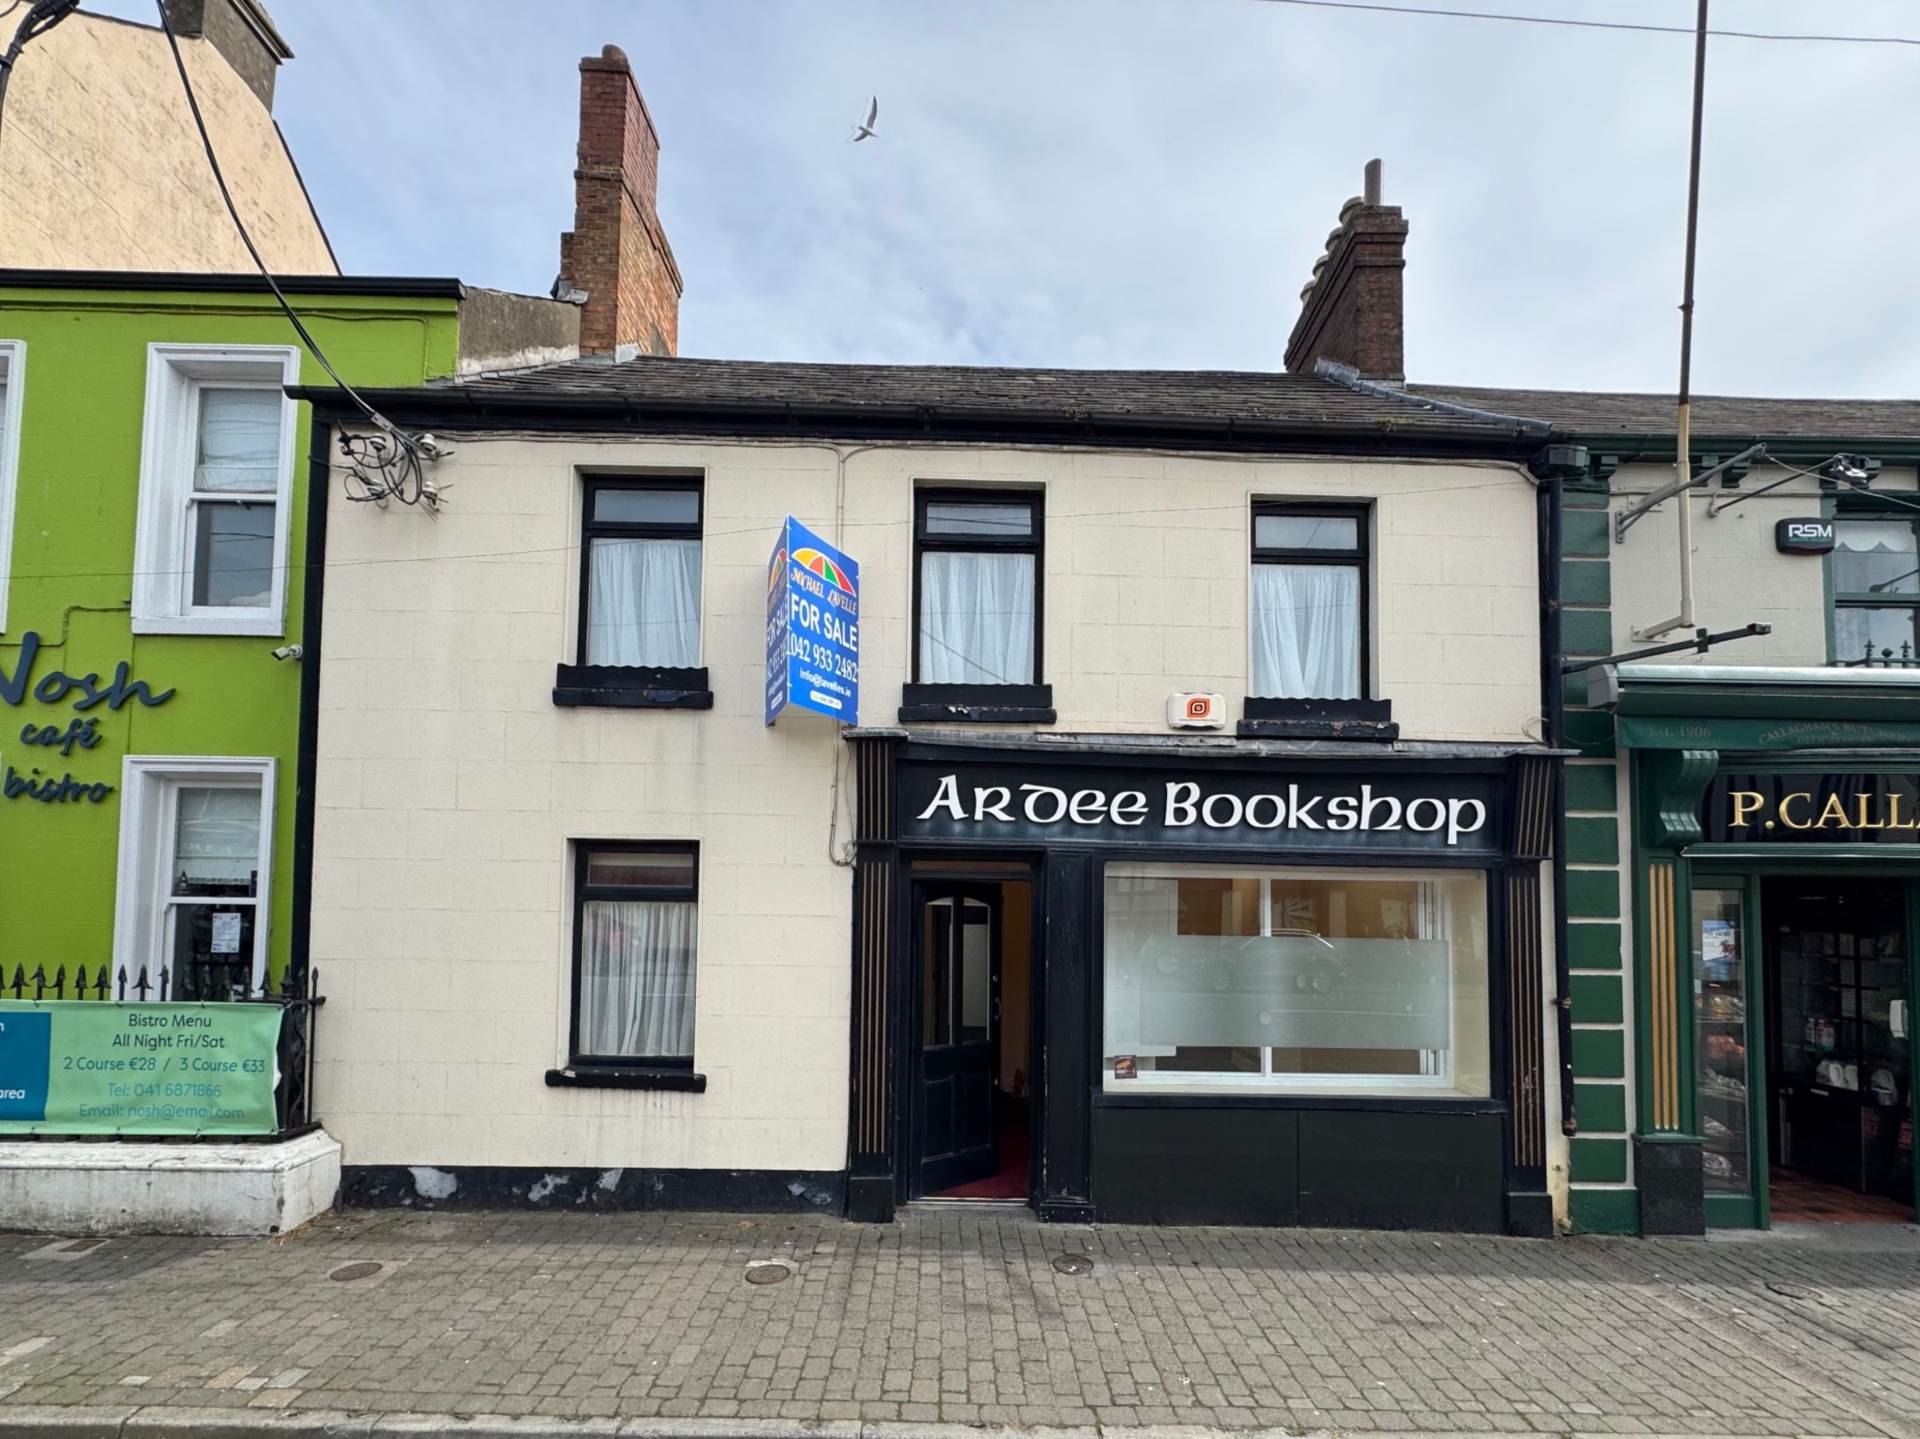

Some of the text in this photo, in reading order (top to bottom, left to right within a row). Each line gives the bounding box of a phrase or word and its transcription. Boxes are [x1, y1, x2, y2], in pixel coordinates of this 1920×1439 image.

[1788, 524, 1832, 537] RSM
[791, 567, 824, 599] MICHAEL
[791, 592, 821, 634] FOR
[823, 611, 857, 652] SALE
[791, 632, 811, 663] 042
[813, 643, 833, 672] 933
[834, 653, 858, 683] 2482
[20, 717, 103, 756] café
[1680, 725, 1713, 737] 1906
[4, 766, 114, 803] bistro
[1164, 782, 1486, 845] Bookshop
[1728, 791, 1920, 830] P.CALL
[128, 1013, 212, 1028] Bistro Menu
[112, 1033, 226, 1051] All Night Fri/Sat
[63, 1056, 266, 1073] 2 Course €28 / 3 Course €33
[107, 1082, 222, 1098] Tel: 041 6871866
[79, 1103, 124, 1118] Email:
